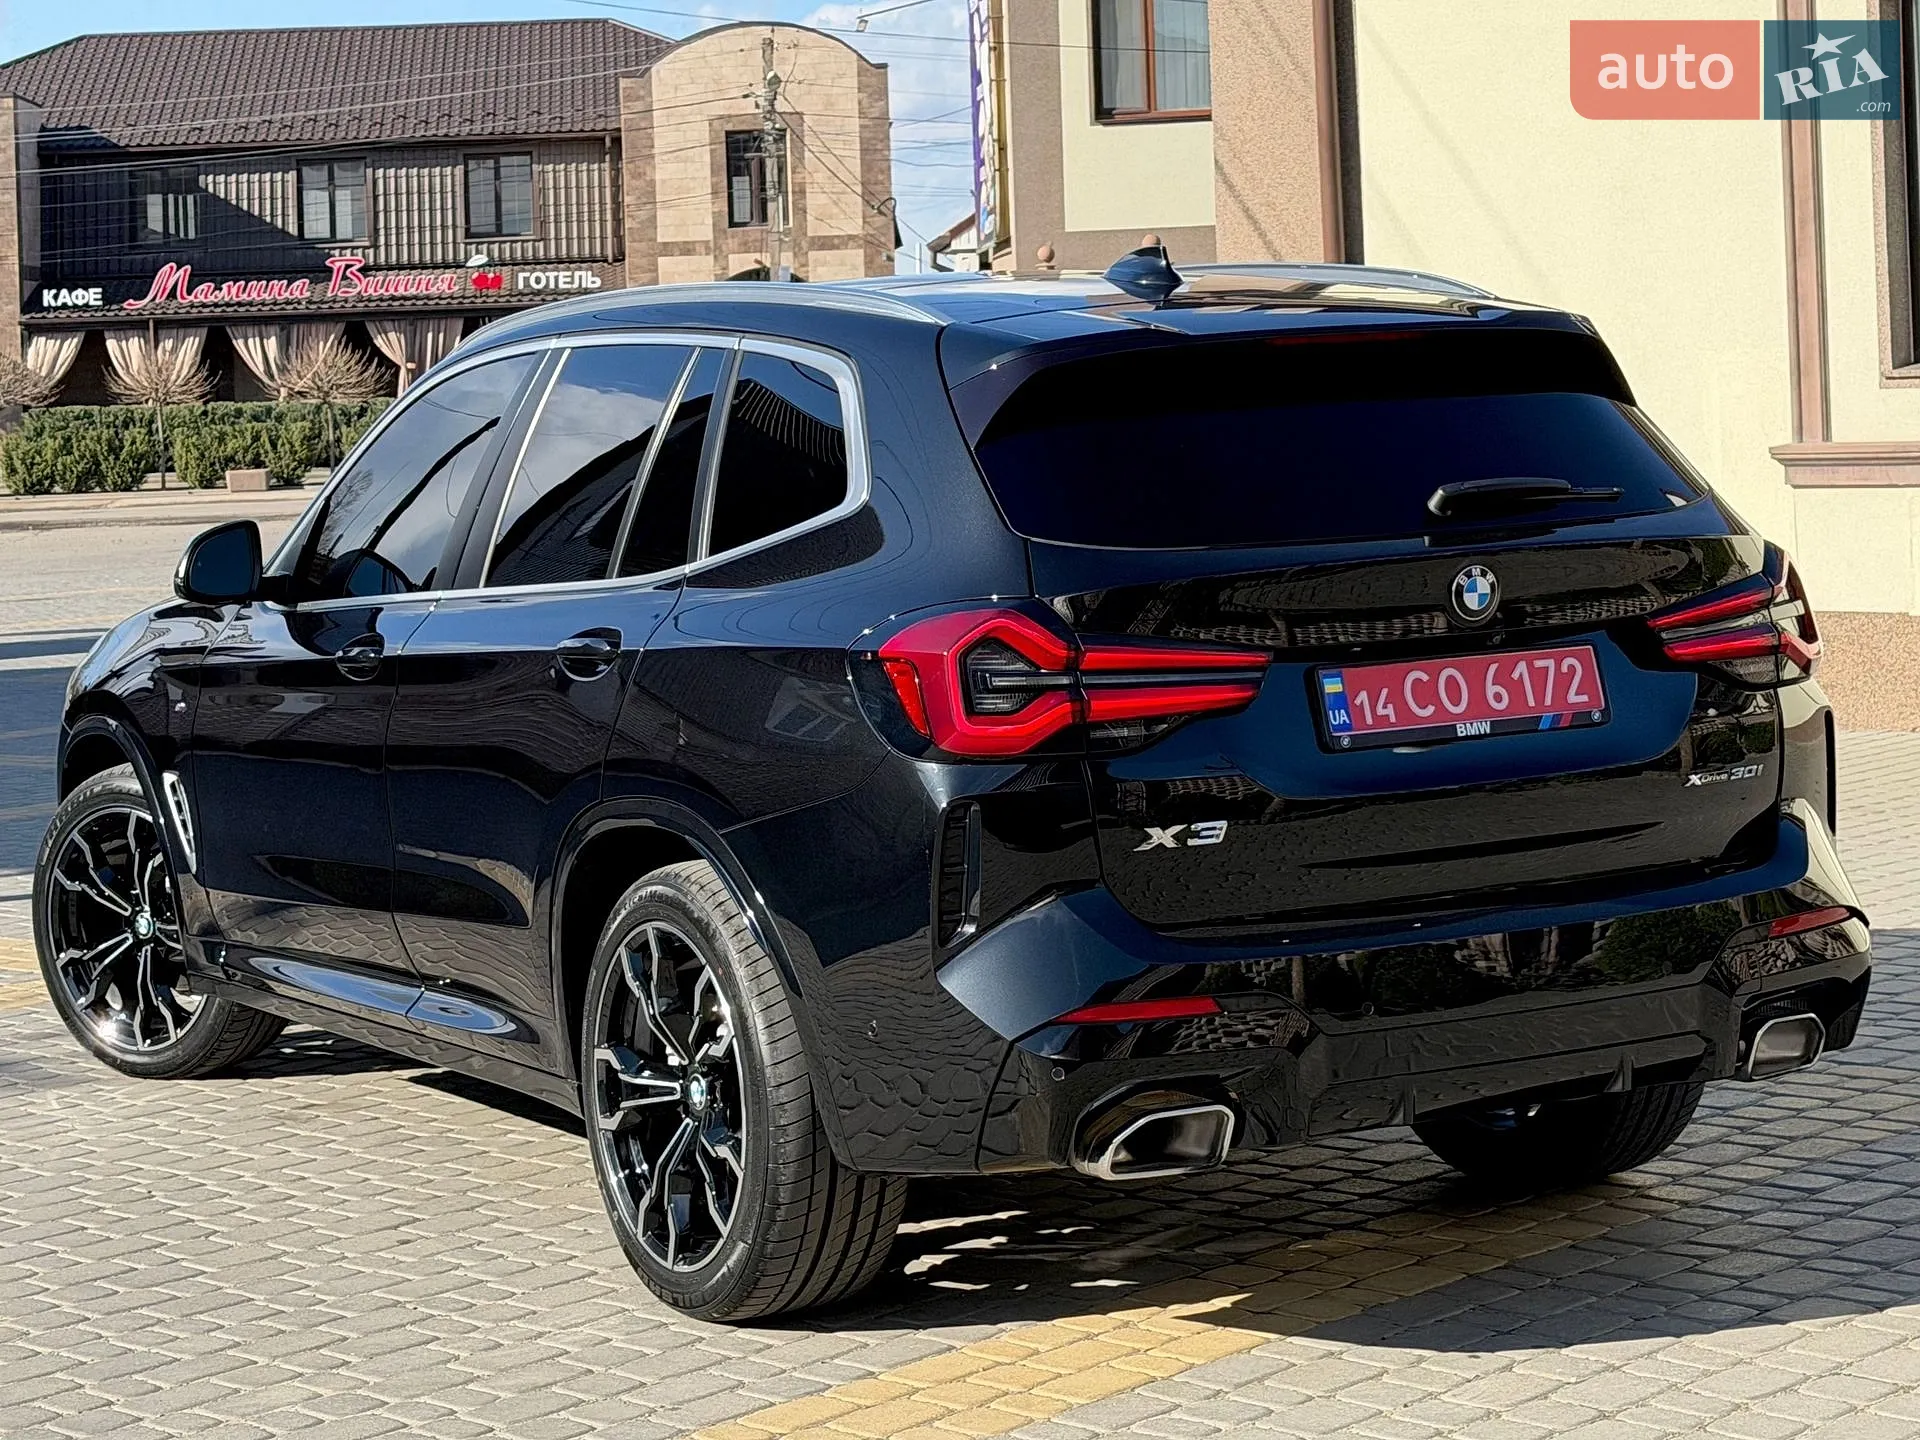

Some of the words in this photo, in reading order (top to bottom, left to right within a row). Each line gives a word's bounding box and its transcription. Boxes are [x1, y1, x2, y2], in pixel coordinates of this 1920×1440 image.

[123, 262, 311, 309] Мамина
[325, 256, 459, 297] Вишня
[517, 271, 602, 289] ГОТЕЛЬ
[42, 288, 103, 307] КАФЕ
[1458, 567, 1494, 586] BMW
[1353, 687, 1397, 725] 14
[1403, 667, 1469, 718] CO
[1485, 656, 1589, 711] 6172
[1329, 710, 1350, 726] UA
[1456, 721, 1491, 738] BMW
[1132, 820, 1228, 852] X3
